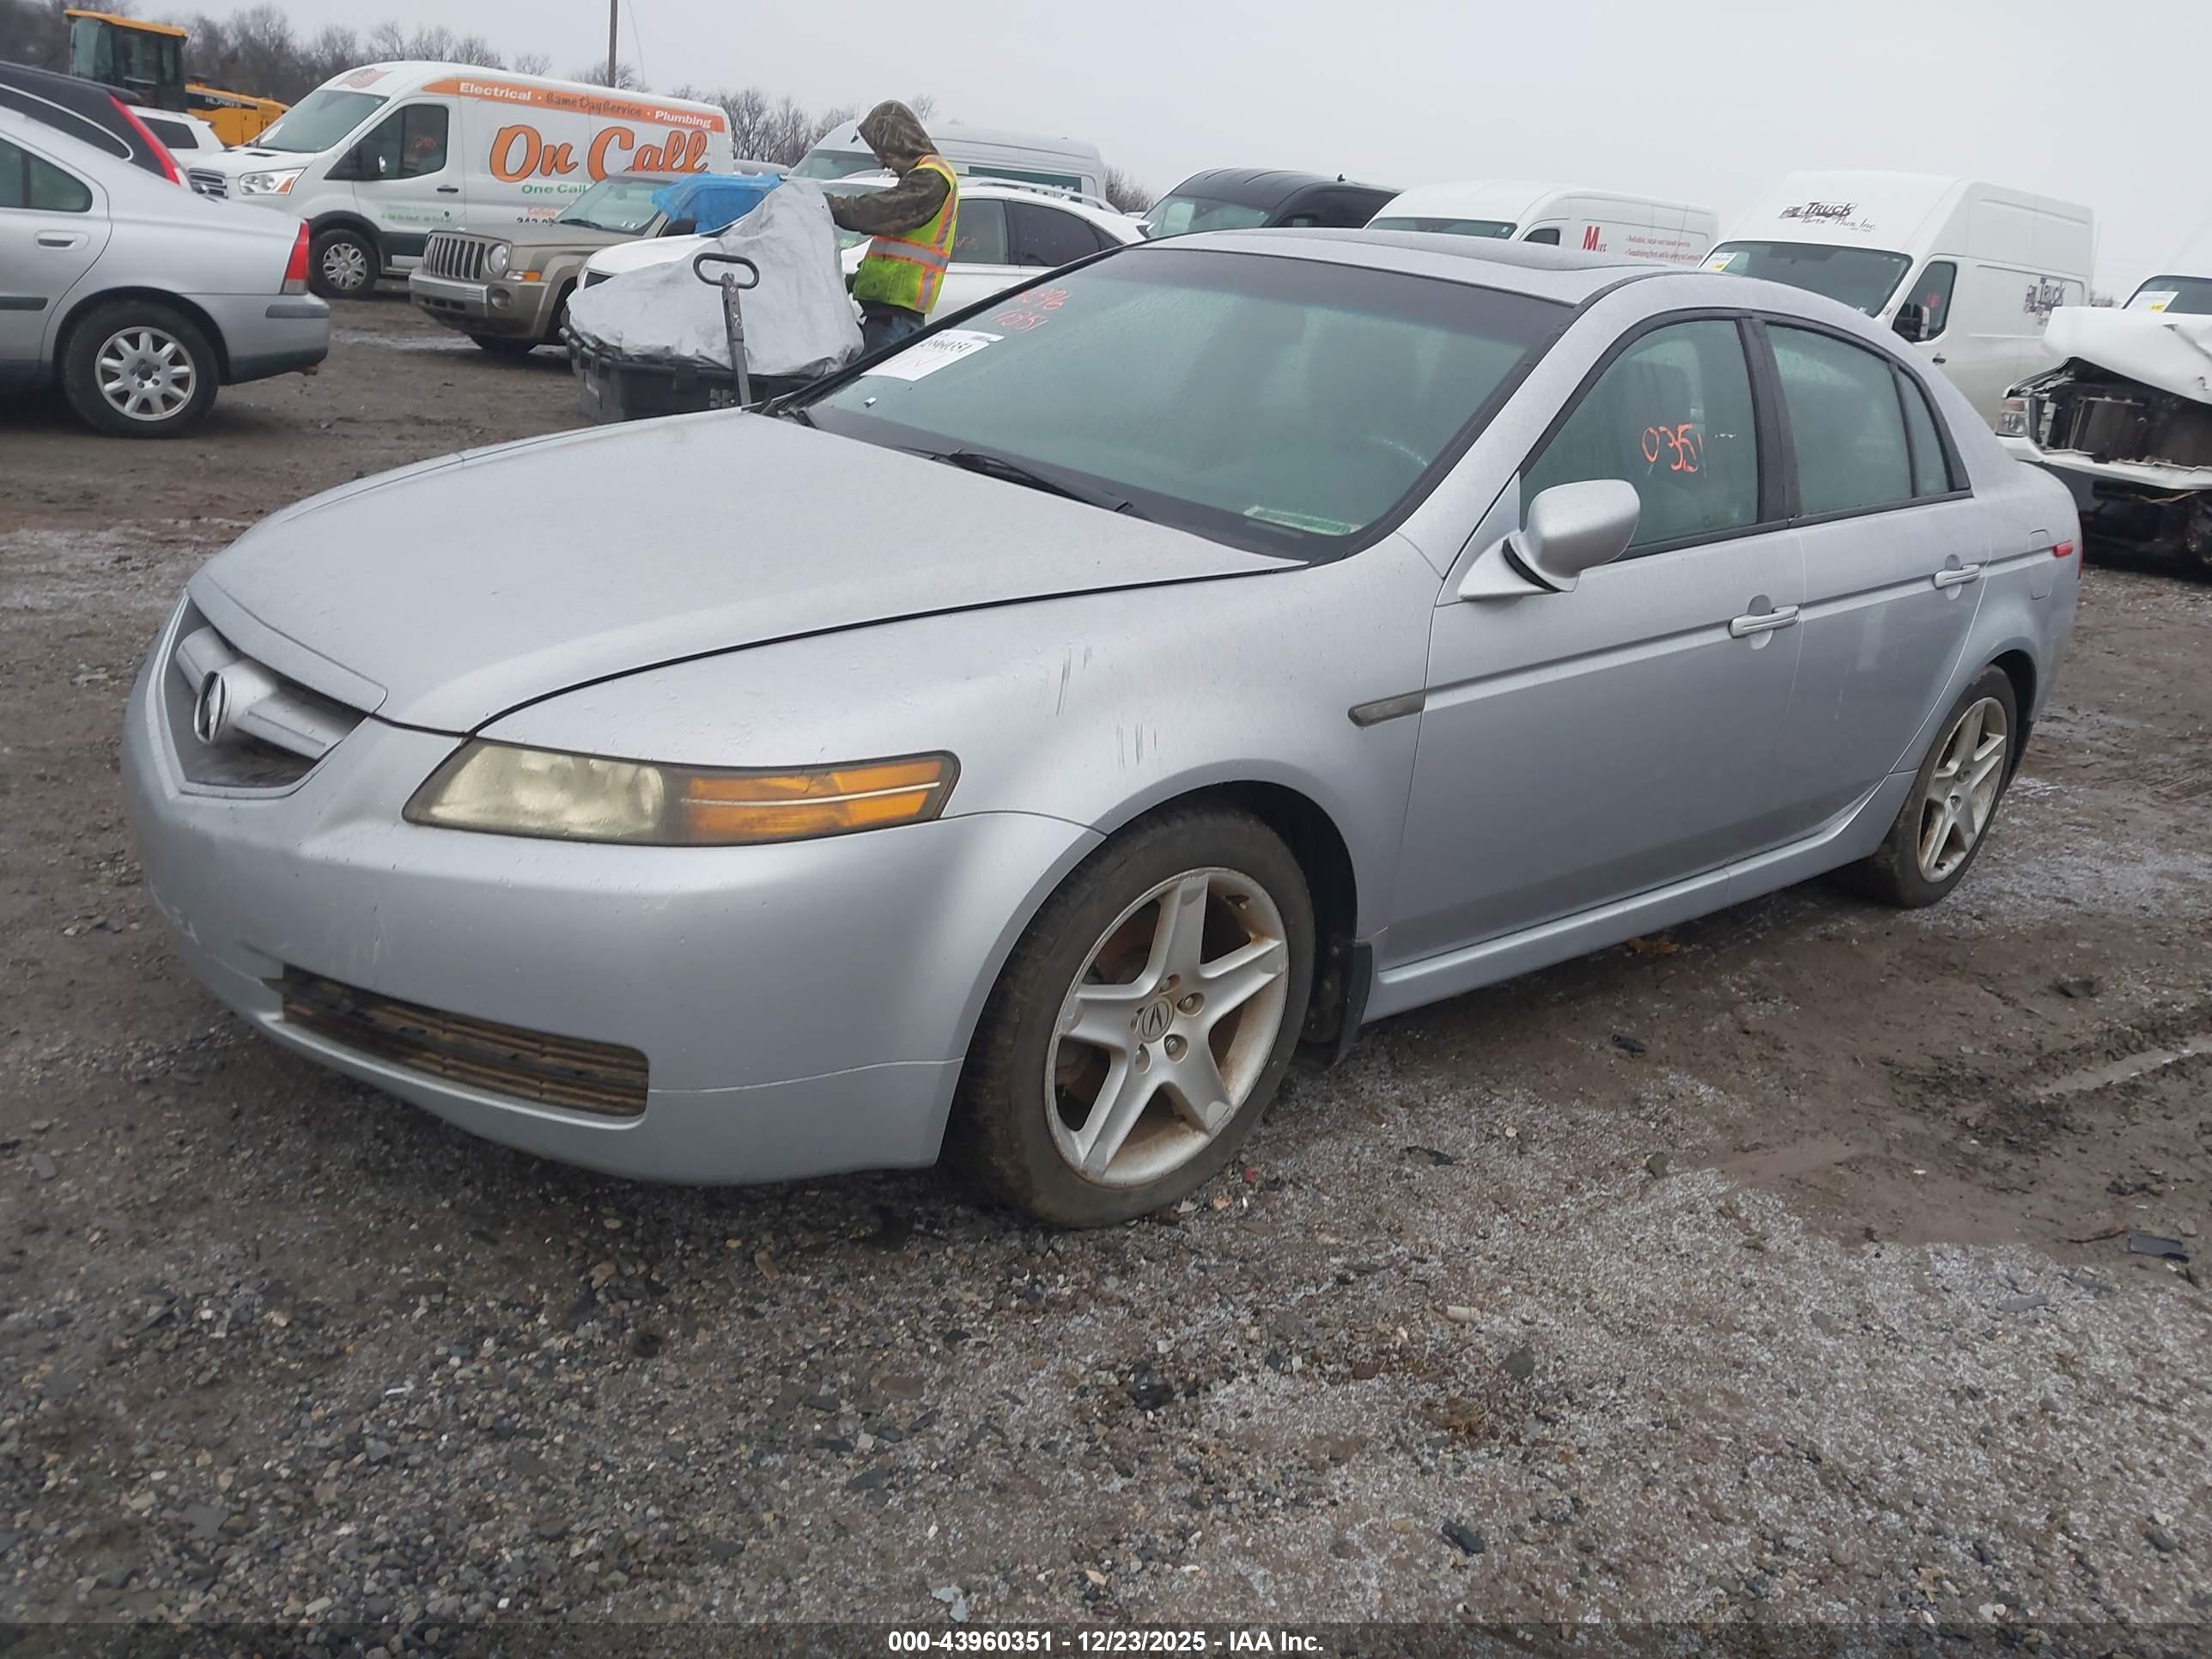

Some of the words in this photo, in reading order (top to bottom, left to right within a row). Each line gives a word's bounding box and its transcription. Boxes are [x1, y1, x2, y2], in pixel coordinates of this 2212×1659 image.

[459, 82, 532, 101] Electrical
[654, 109, 713, 128] Plumbing
[489, 124, 579, 183] On
[587, 126, 708, 184] Call
[521, 184, 554, 194] One
[557, 184, 586, 194] Call
